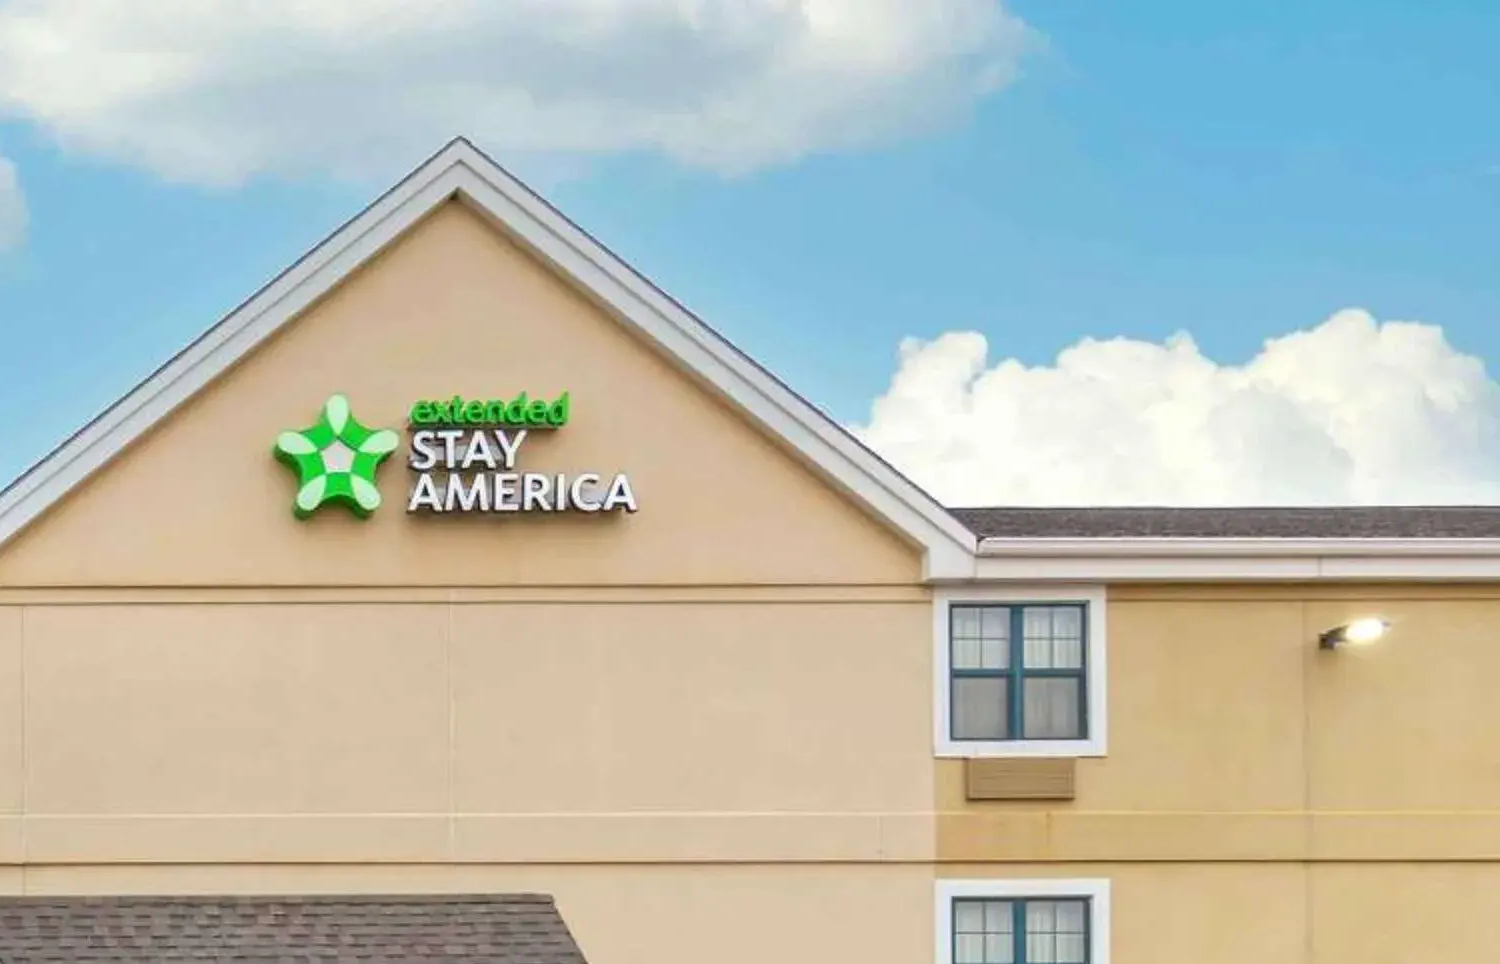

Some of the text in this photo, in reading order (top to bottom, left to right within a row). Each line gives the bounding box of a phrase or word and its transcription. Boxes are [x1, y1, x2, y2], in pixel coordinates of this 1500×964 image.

[409, 391, 569, 426] extended
[410, 429, 528, 470] STAY
[407, 473, 638, 512] AMERICA
